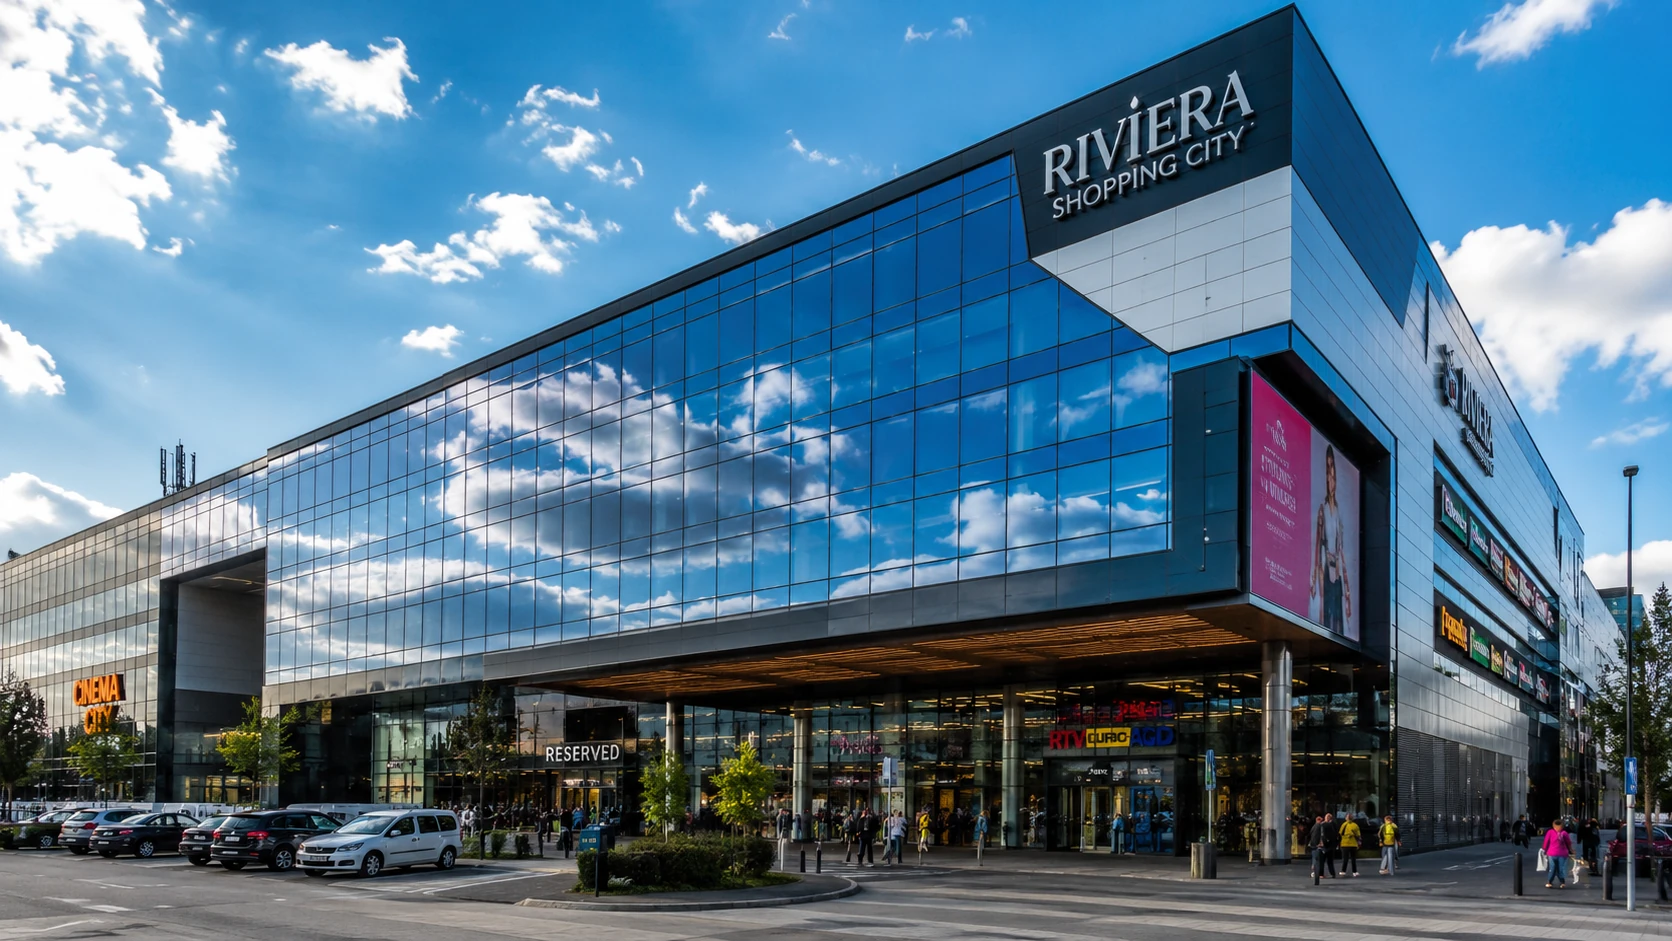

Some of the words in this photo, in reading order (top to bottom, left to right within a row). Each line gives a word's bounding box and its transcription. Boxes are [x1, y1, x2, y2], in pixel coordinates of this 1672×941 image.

[1052, 154, 1178, 219] SHOPPING
[1185, 125, 1246, 167] CITY
[73, 673, 120, 706] CINEMA
[84, 705, 112, 735] CITY
[545, 744, 620, 762] RESERVED
[1049, 729, 1086, 750] RTV
